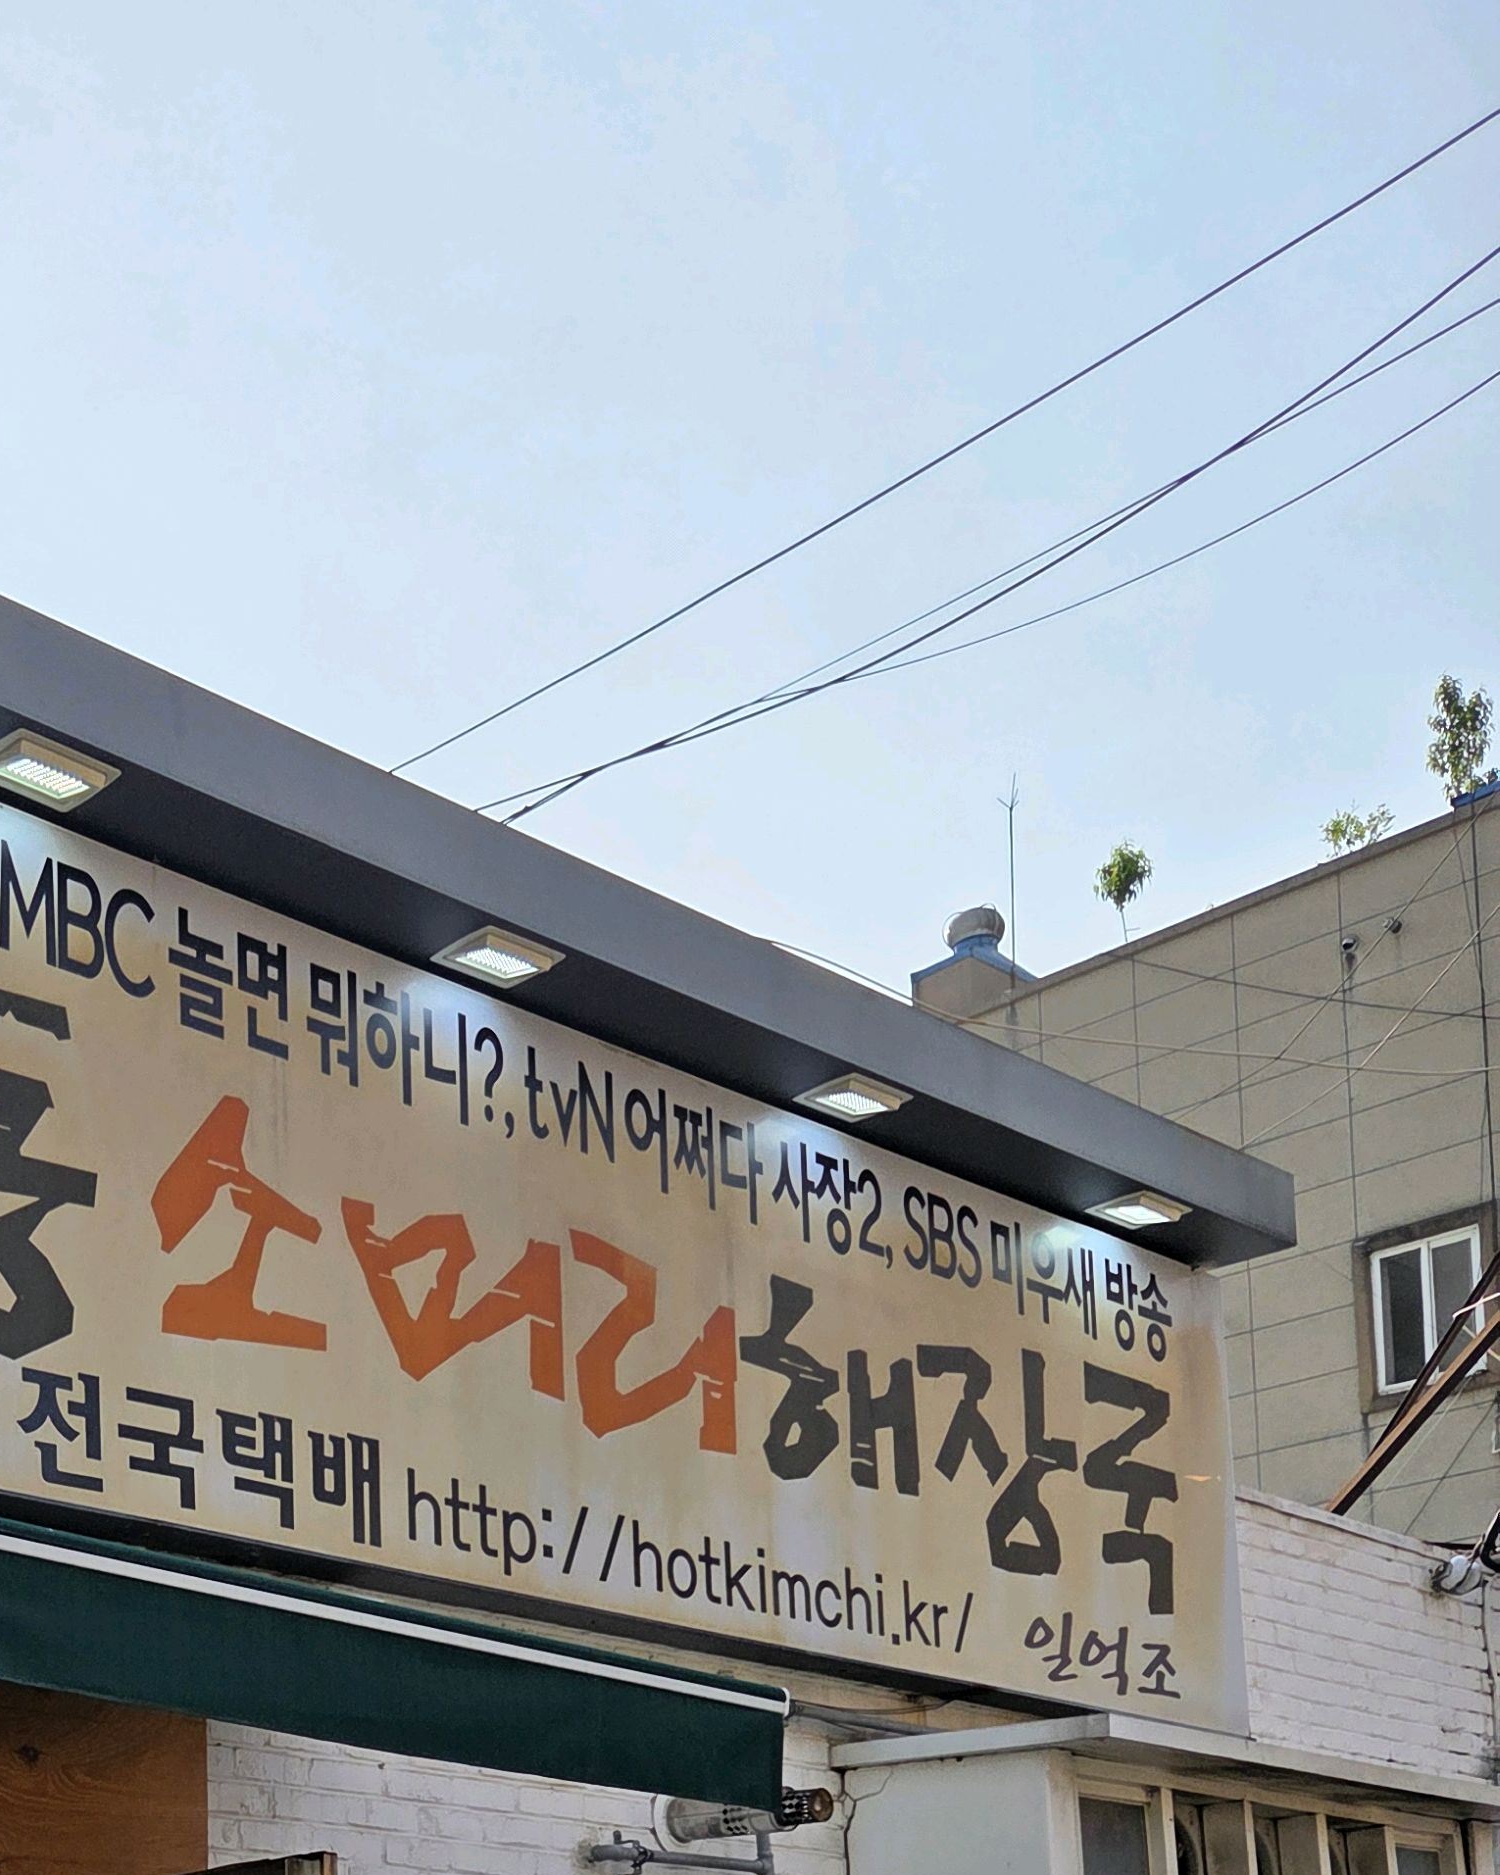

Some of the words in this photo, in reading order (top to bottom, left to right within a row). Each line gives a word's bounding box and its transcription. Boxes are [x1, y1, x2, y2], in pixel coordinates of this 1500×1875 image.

[167, 905, 289, 1061] 놀면
[902, 1185, 983, 1288] SBS
[989, 1219, 1098, 1341] 미우새
[1104, 1257, 1174, 1363] 방송
[407, 1467, 974, 1655] http://hotkimchi.kr/
